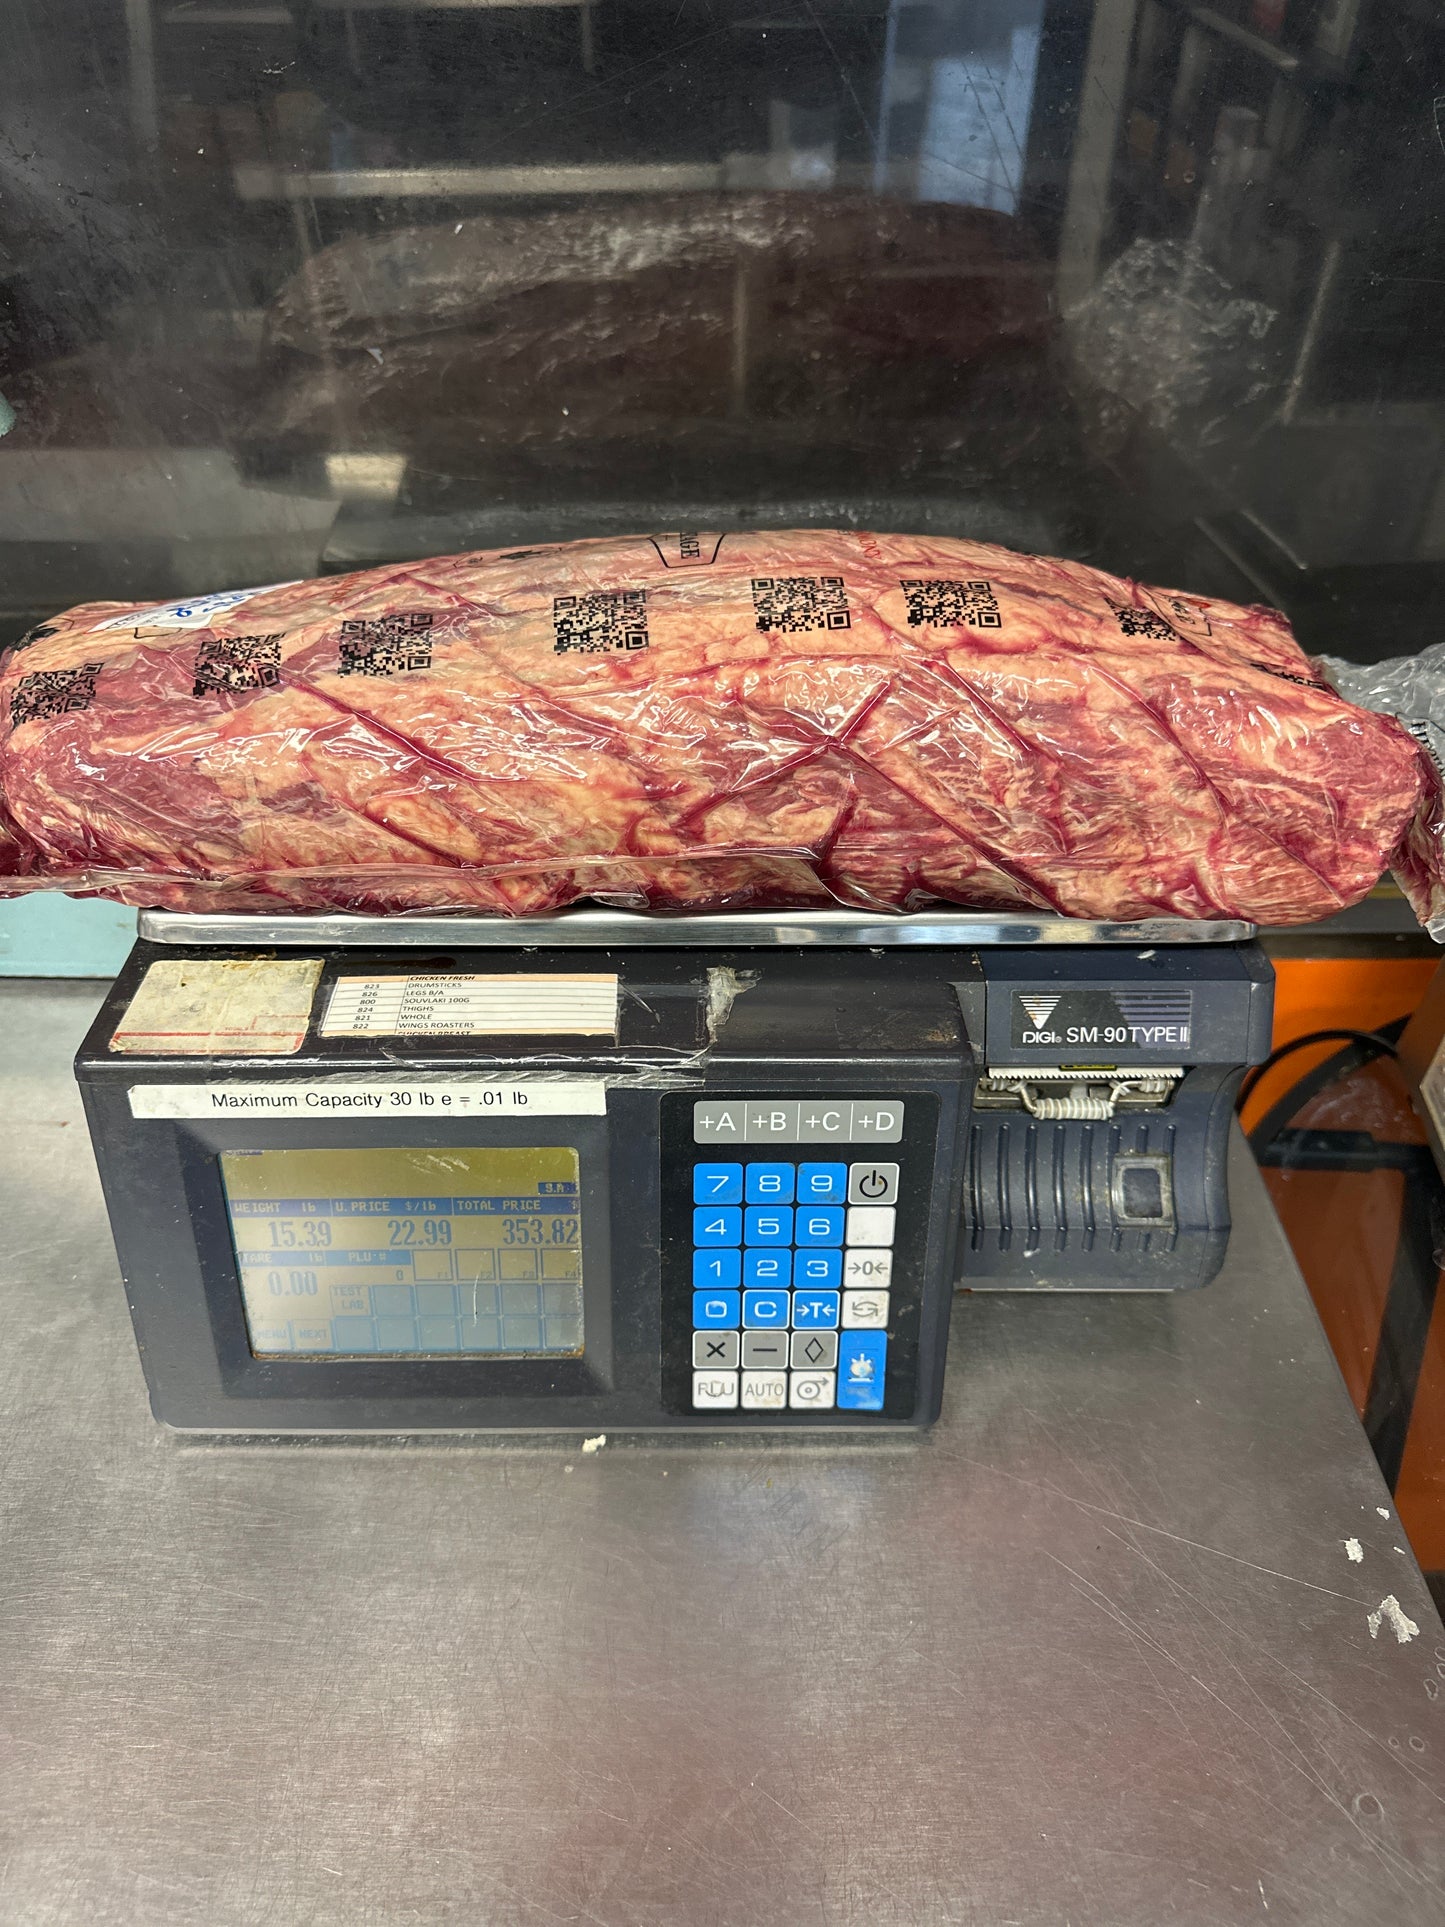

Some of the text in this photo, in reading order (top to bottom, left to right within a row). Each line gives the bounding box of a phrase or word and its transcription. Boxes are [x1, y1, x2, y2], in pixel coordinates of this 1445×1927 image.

[1066, 1026, 1127, 1043] SM-90
[211, 1093, 298, 1107] Maximum
[305, 1092, 383, 1108] Capacity
[390, 1092, 412, 1106] 30
[419, 1092, 435, 1105] lb
[441, 1095, 452, 1106] e
[479, 1091, 503, 1105] .01
[512, 1091, 528, 1105] lb
[699, 1112, 736, 1132] +A
[752, 1111, 787, 1131] +B
[805, 1111, 841, 1131] +C
[858, 1111, 895, 1131] +D
[706, 1175, 729, 1193] 7
[758, 1174, 781, 1193] 8
[810, 1174, 833, 1193] 9
[234, 1201, 316, 1213] WEIGHT lb
[404, 1201, 437, 1212] $/lb
[456, 1200, 495, 1211] TOTAL
[502, 1200, 541, 1211] PRICE
[268, 1220, 333, 1248] 15.39
[387, 1219, 452, 1246] 22.99
[502, 1218, 579, 1245] 353.82
[704, 1218, 727, 1236] 4
[757, 1218, 780, 1235] 5
[808, 1218, 831, 1235] 6
[243, 1252, 273, 1263] TARE
[348, 1252, 372, 1262] PLU
[709, 1260, 721, 1277] 1
[756, 1260, 779, 1277] 2
[806, 1260, 829, 1277] 3
[268, 1271, 318, 1296] 0.00
[333, 1286, 362, 1296] TEST
[754, 1301, 777, 1318] C
[299, 1329, 327, 1339] NEXT
[745, 1383, 784, 1397] AUTO
